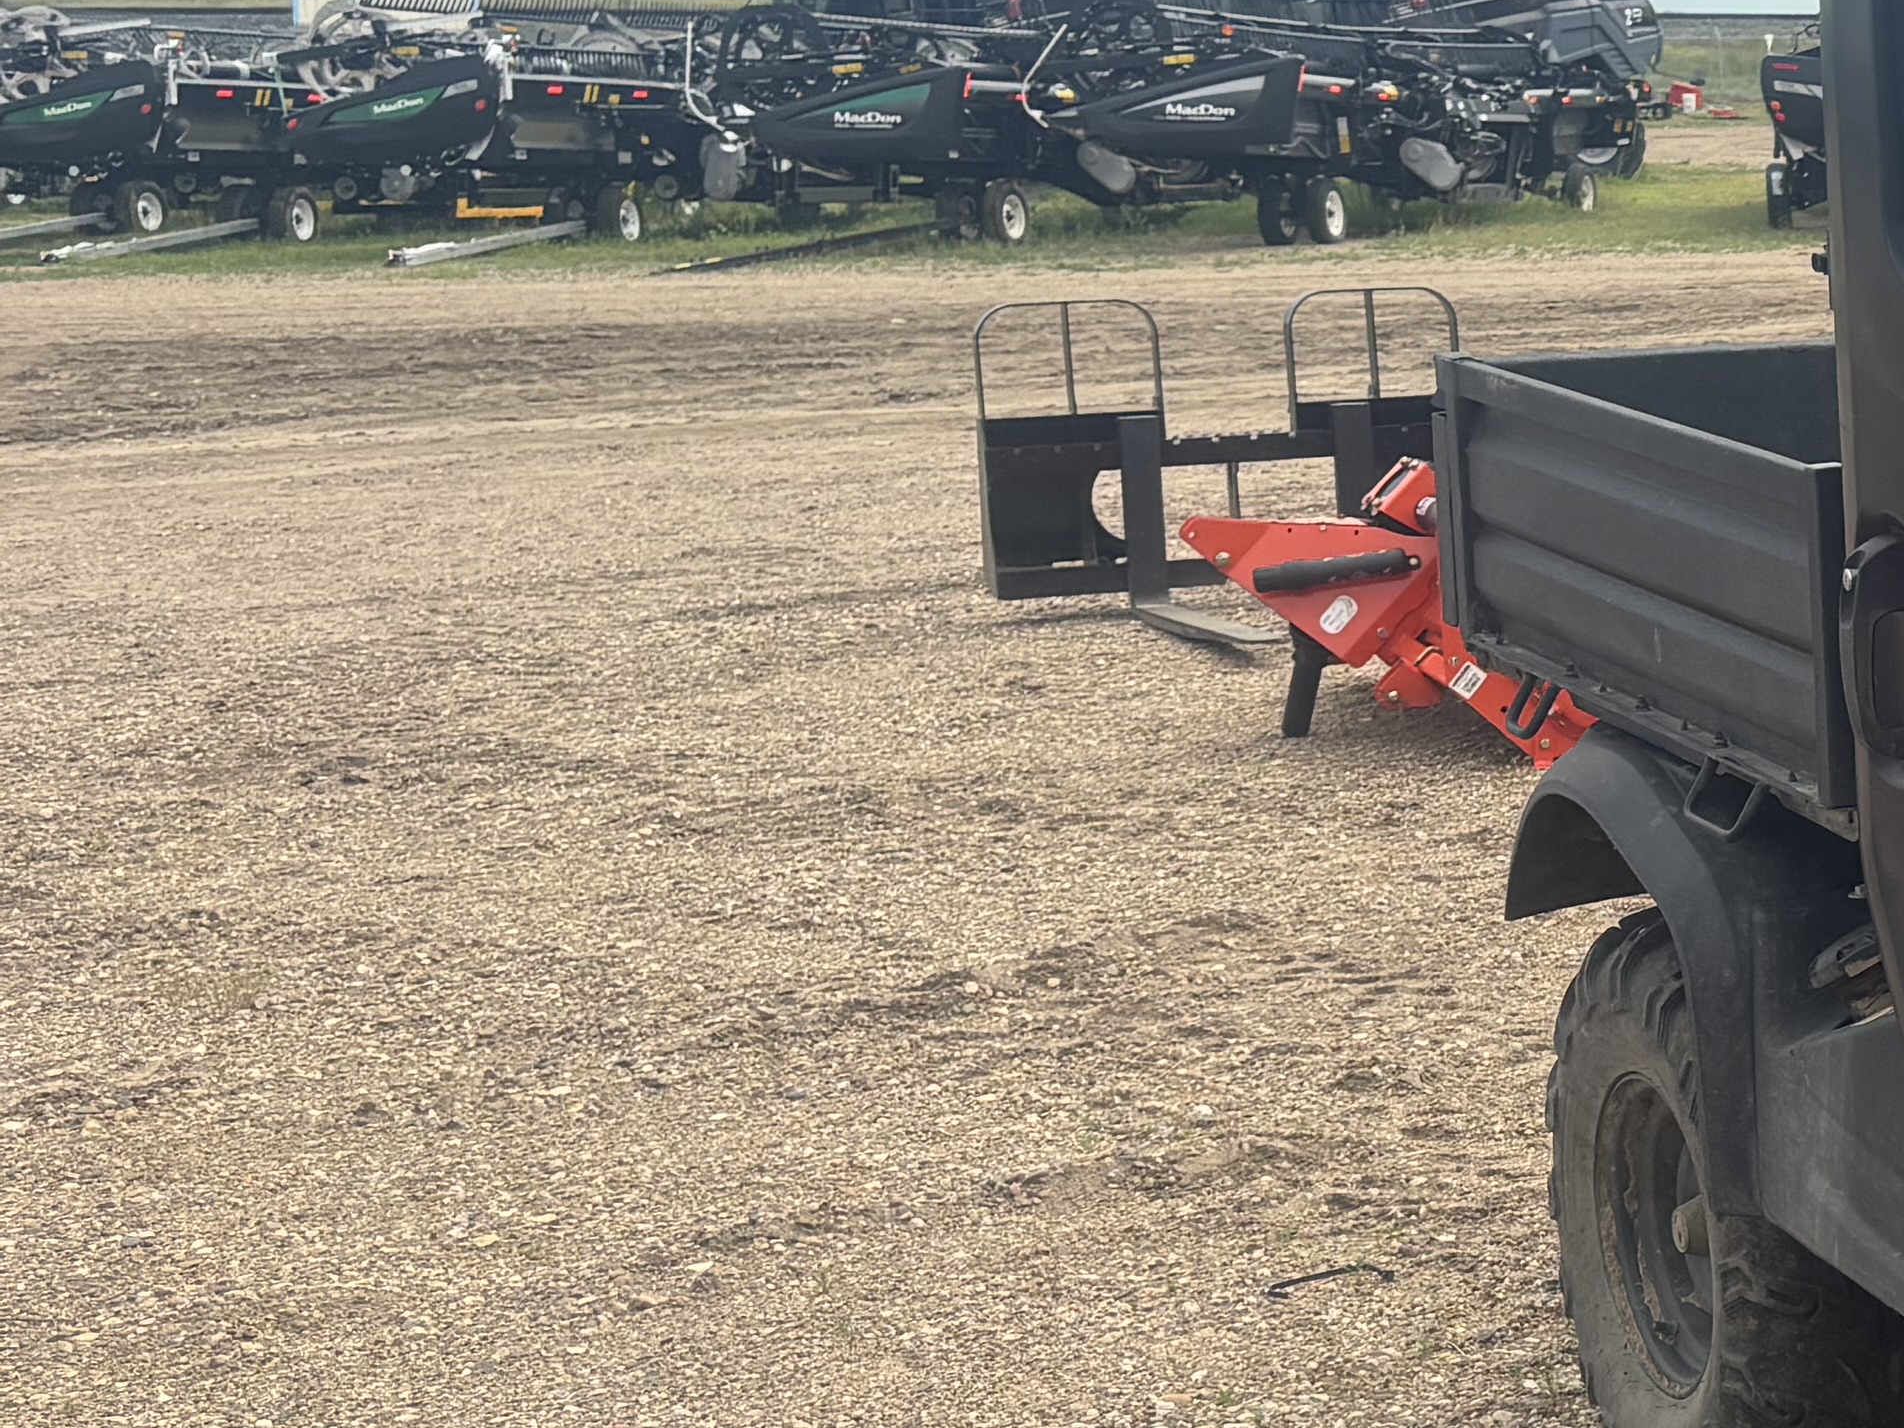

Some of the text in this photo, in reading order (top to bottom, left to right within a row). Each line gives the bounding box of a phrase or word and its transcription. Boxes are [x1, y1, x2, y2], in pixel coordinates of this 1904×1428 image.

[373, 97, 424, 114] MacDon
[1165, 103, 1236, 117] MacDon
[834, 111, 902, 124] MacDon
